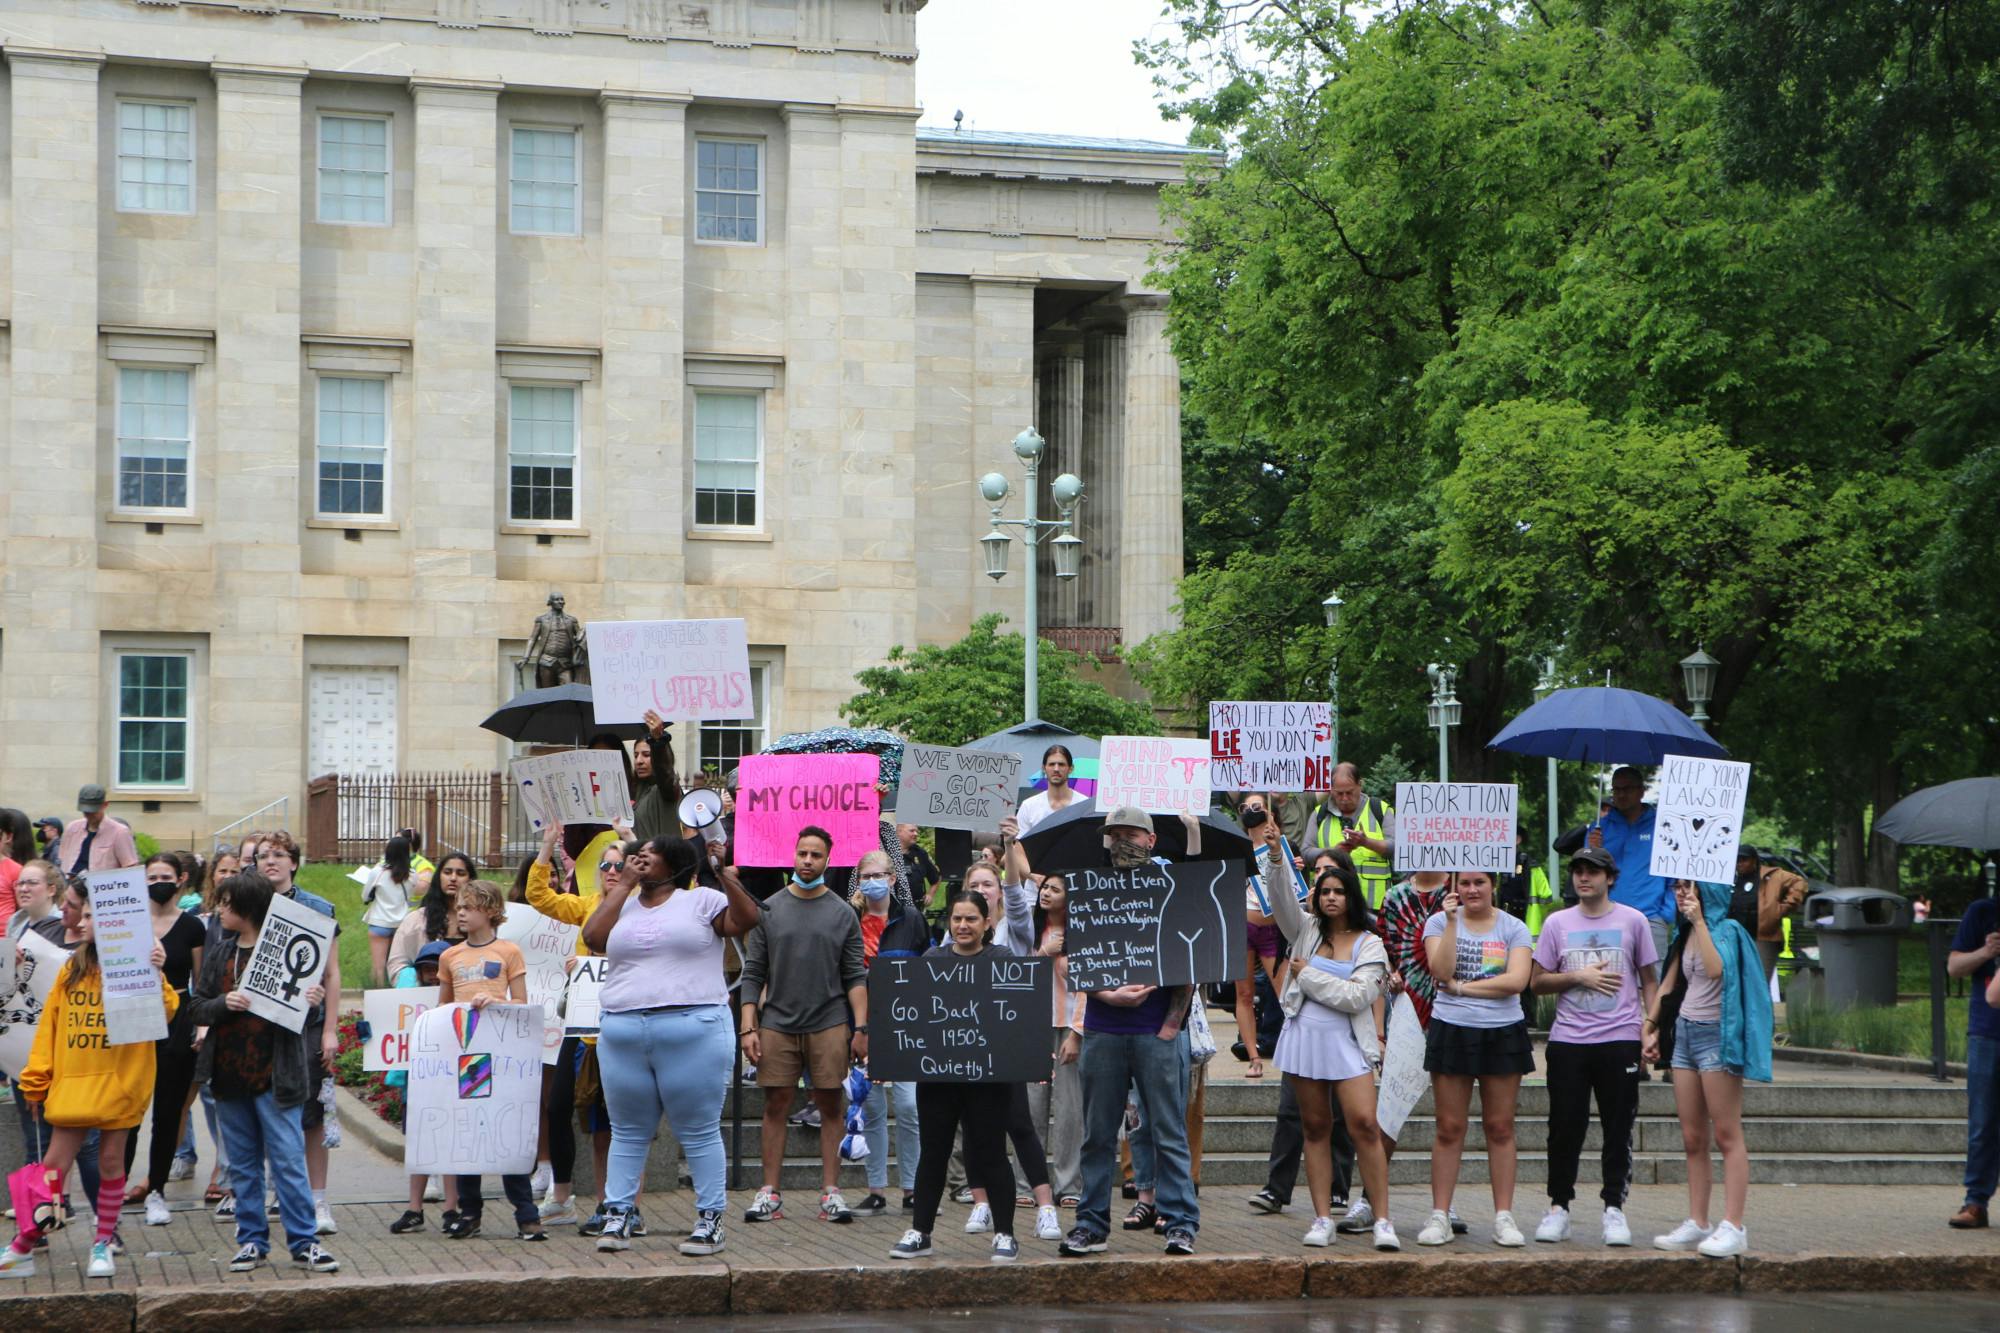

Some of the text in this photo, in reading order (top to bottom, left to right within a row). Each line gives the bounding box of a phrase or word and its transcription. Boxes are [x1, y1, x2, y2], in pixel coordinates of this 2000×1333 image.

[642, 621, 708, 649] POLITICS
[601, 650, 666, 683] religion
[1283, 704, 1296, 727] IS
[1105, 740, 1172, 763] MIND
[1247, 730, 1271, 753] YOU
[1276, 728, 1321, 753] DON'T
[749, 757, 857, 785] MY BODY
[913, 749, 1022, 776] WE WON'T
[1252, 760, 1260, 783] IF
[1263, 757, 1301, 786] WOMEN
[946, 774, 978, 796] GO
[1105, 763, 1168, 787] YOUR
[1667, 759, 1745, 790] KEEP YOUR
[748, 782, 874, 812] MY CHOICE.
[928, 791, 991, 818] BACK
[1102, 786, 1208, 809] UTERUS
[1402, 784, 1510, 815] ABORTION
[1664, 785, 1738, 809] LAWS OFF
[748, 813, 783, 838] MY
[1403, 816, 1510, 831] IS HEALTHCARE
[1407, 831, 1507, 844] HEALTHCARE IS A
[748, 839, 783, 865] MY
[1398, 844, 1513, 870] HUMAN RIGHT
[1656, 855, 1728, 880] MY BODY
[94, 881, 129, 894] you're
[1065, 868, 1168, 891] I Don't Even
[1069, 896, 1154, 915] Get To Control
[98, 919, 126, 929] POOR
[268, 918, 293, 936] I WILL
[547, 919, 571, 934] NO
[1070, 916, 1086, 933] My
[101, 931, 134, 941] TRANS
[264, 928, 289, 947] NOT GO
[259, 941, 284, 960] QUIETLY
[1107, 940, 1120, 956] I
[1124, 940, 1155, 955] Know
[1567, 950, 1624, 967] MIAMI
[104, 957, 137, 967] BLACK
[253, 962, 284, 980] TO THE
[256, 953, 283, 969] BACK
[1068, 956, 1152, 973] It Better Than
[106, 968, 151, 979] MEXICAN
[534, 969, 565, 992] NO
[890, 960, 1041, 987] I Will NOT
[1070, 974, 1094, 990] You
[108, 980, 156, 992] DISABLED
[891, 995, 1018, 1025] Go Back To
[892, 1028, 987, 1052] The 1950's
[416, 1102, 538, 1167] PEACE
